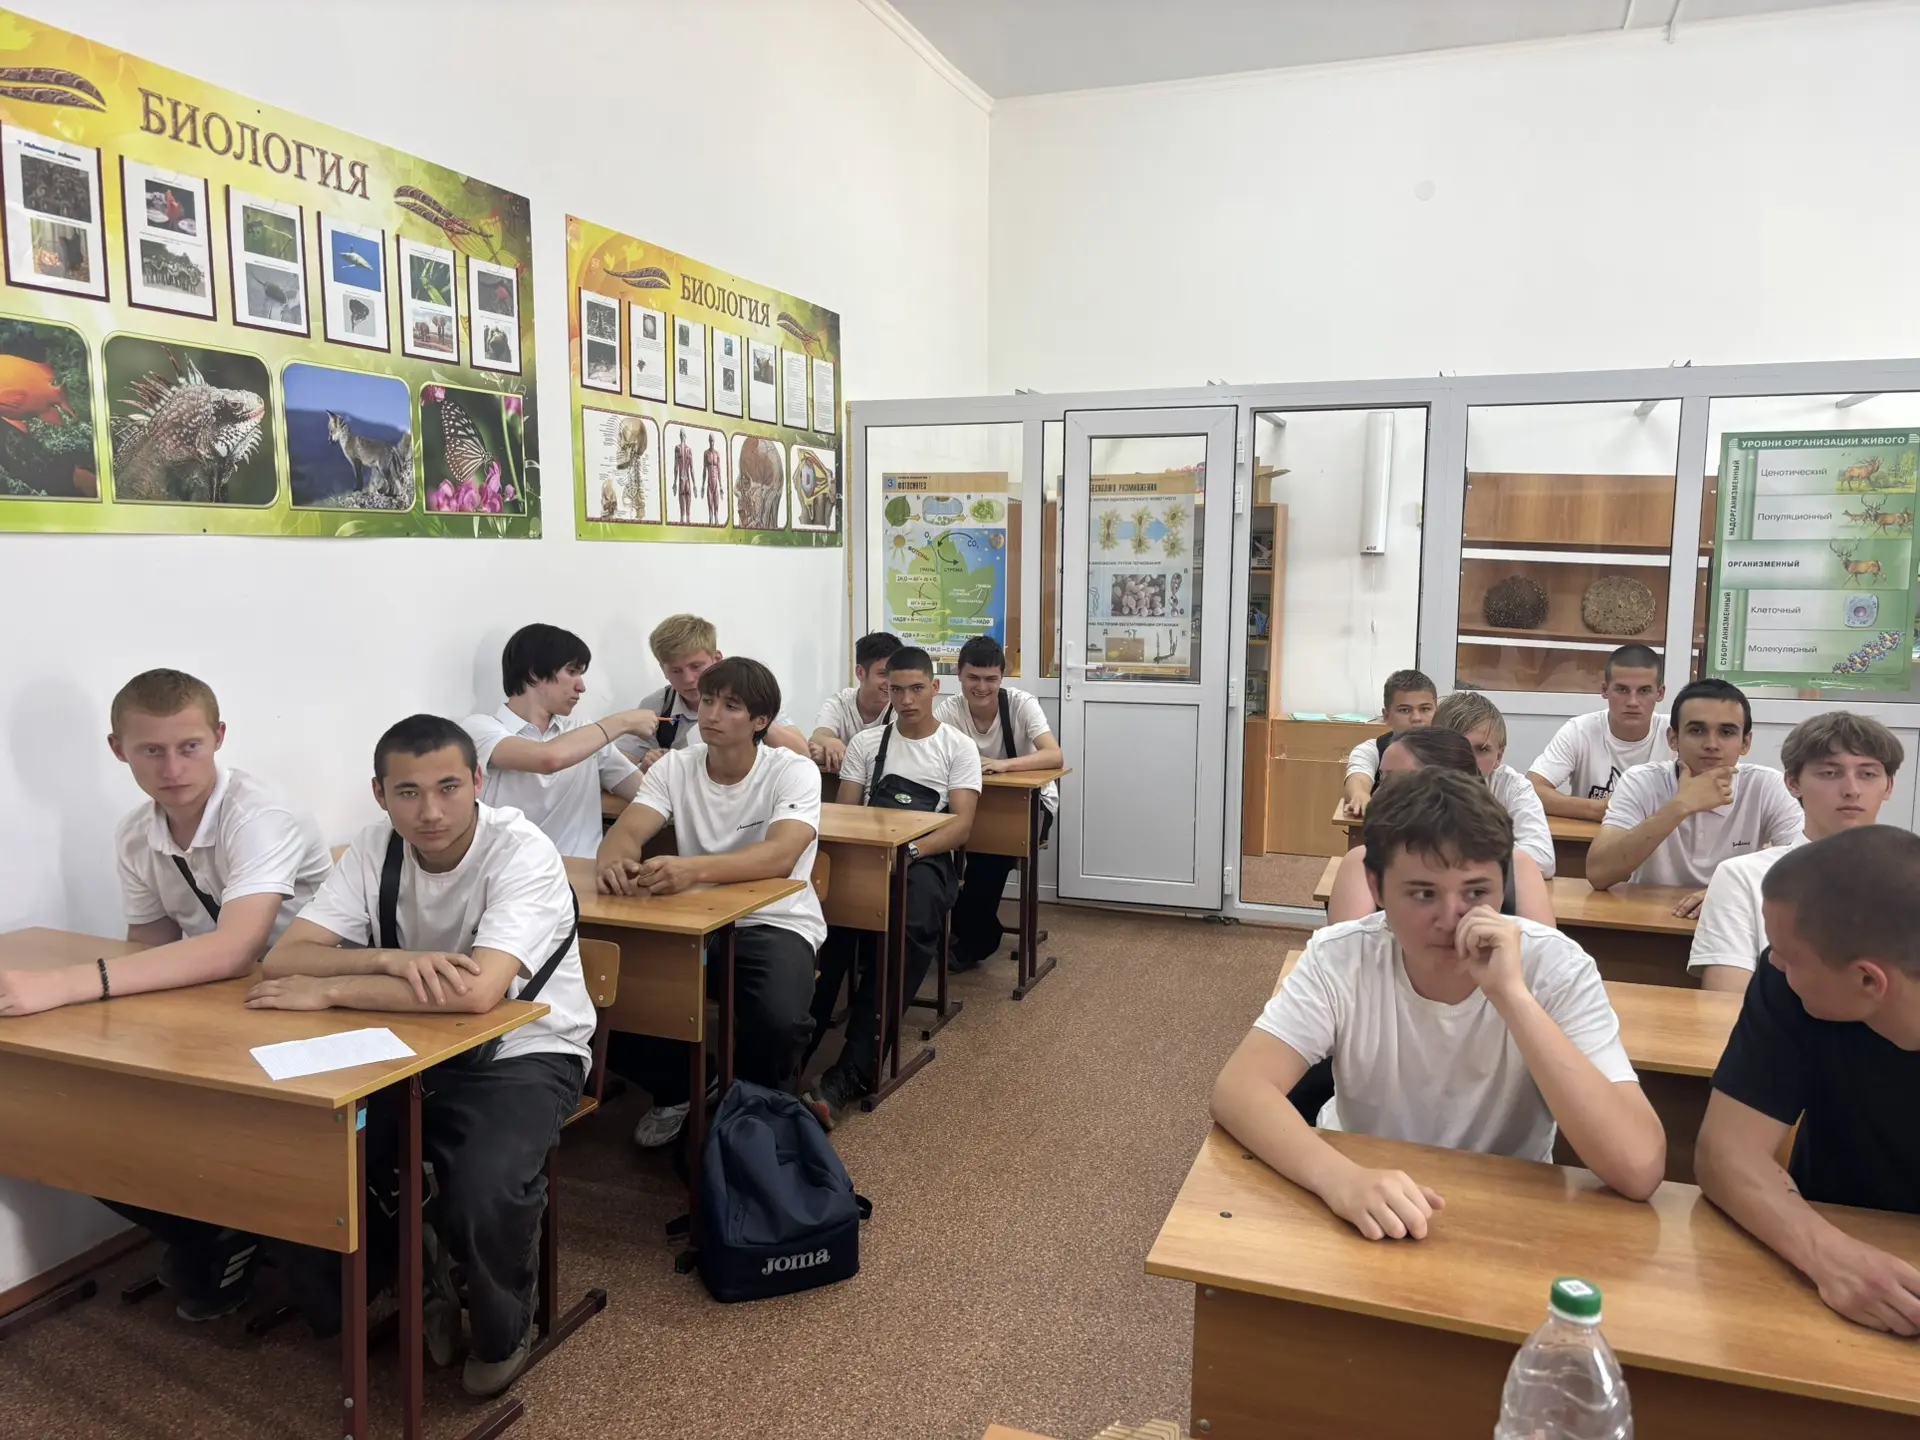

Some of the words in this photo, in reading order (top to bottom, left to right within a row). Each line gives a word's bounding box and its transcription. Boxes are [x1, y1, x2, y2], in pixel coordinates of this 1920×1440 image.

[138, 87, 370, 200] БИОЛОГИЯ
[680, 273, 770, 327] БИОЛОГИЯ
[1741, 439, 1782, 448] УРОВНИ
[1784, 437, 1858, 447] ОРГАНИЗАЦИИ
[1860, 436, 1906, 445] ЖИВОГО
[1760, 468, 1828, 477] Ценотический
[887, 478, 894, 488] 3
[1729, 460, 1740, 536] НАДОРГАНИЗМЕННЫЙ
[1757, 511, 1833, 522] Популяционный
[1727, 560, 1800, 568] ОРГАНИЗМЕННЫЙ
[1750, 605, 1802, 614] Клеточный
[1720, 592, 1731, 666] СУБОРГАНИЗМЕННЫЙ
[1748, 644, 1818, 654] Молекулярный
